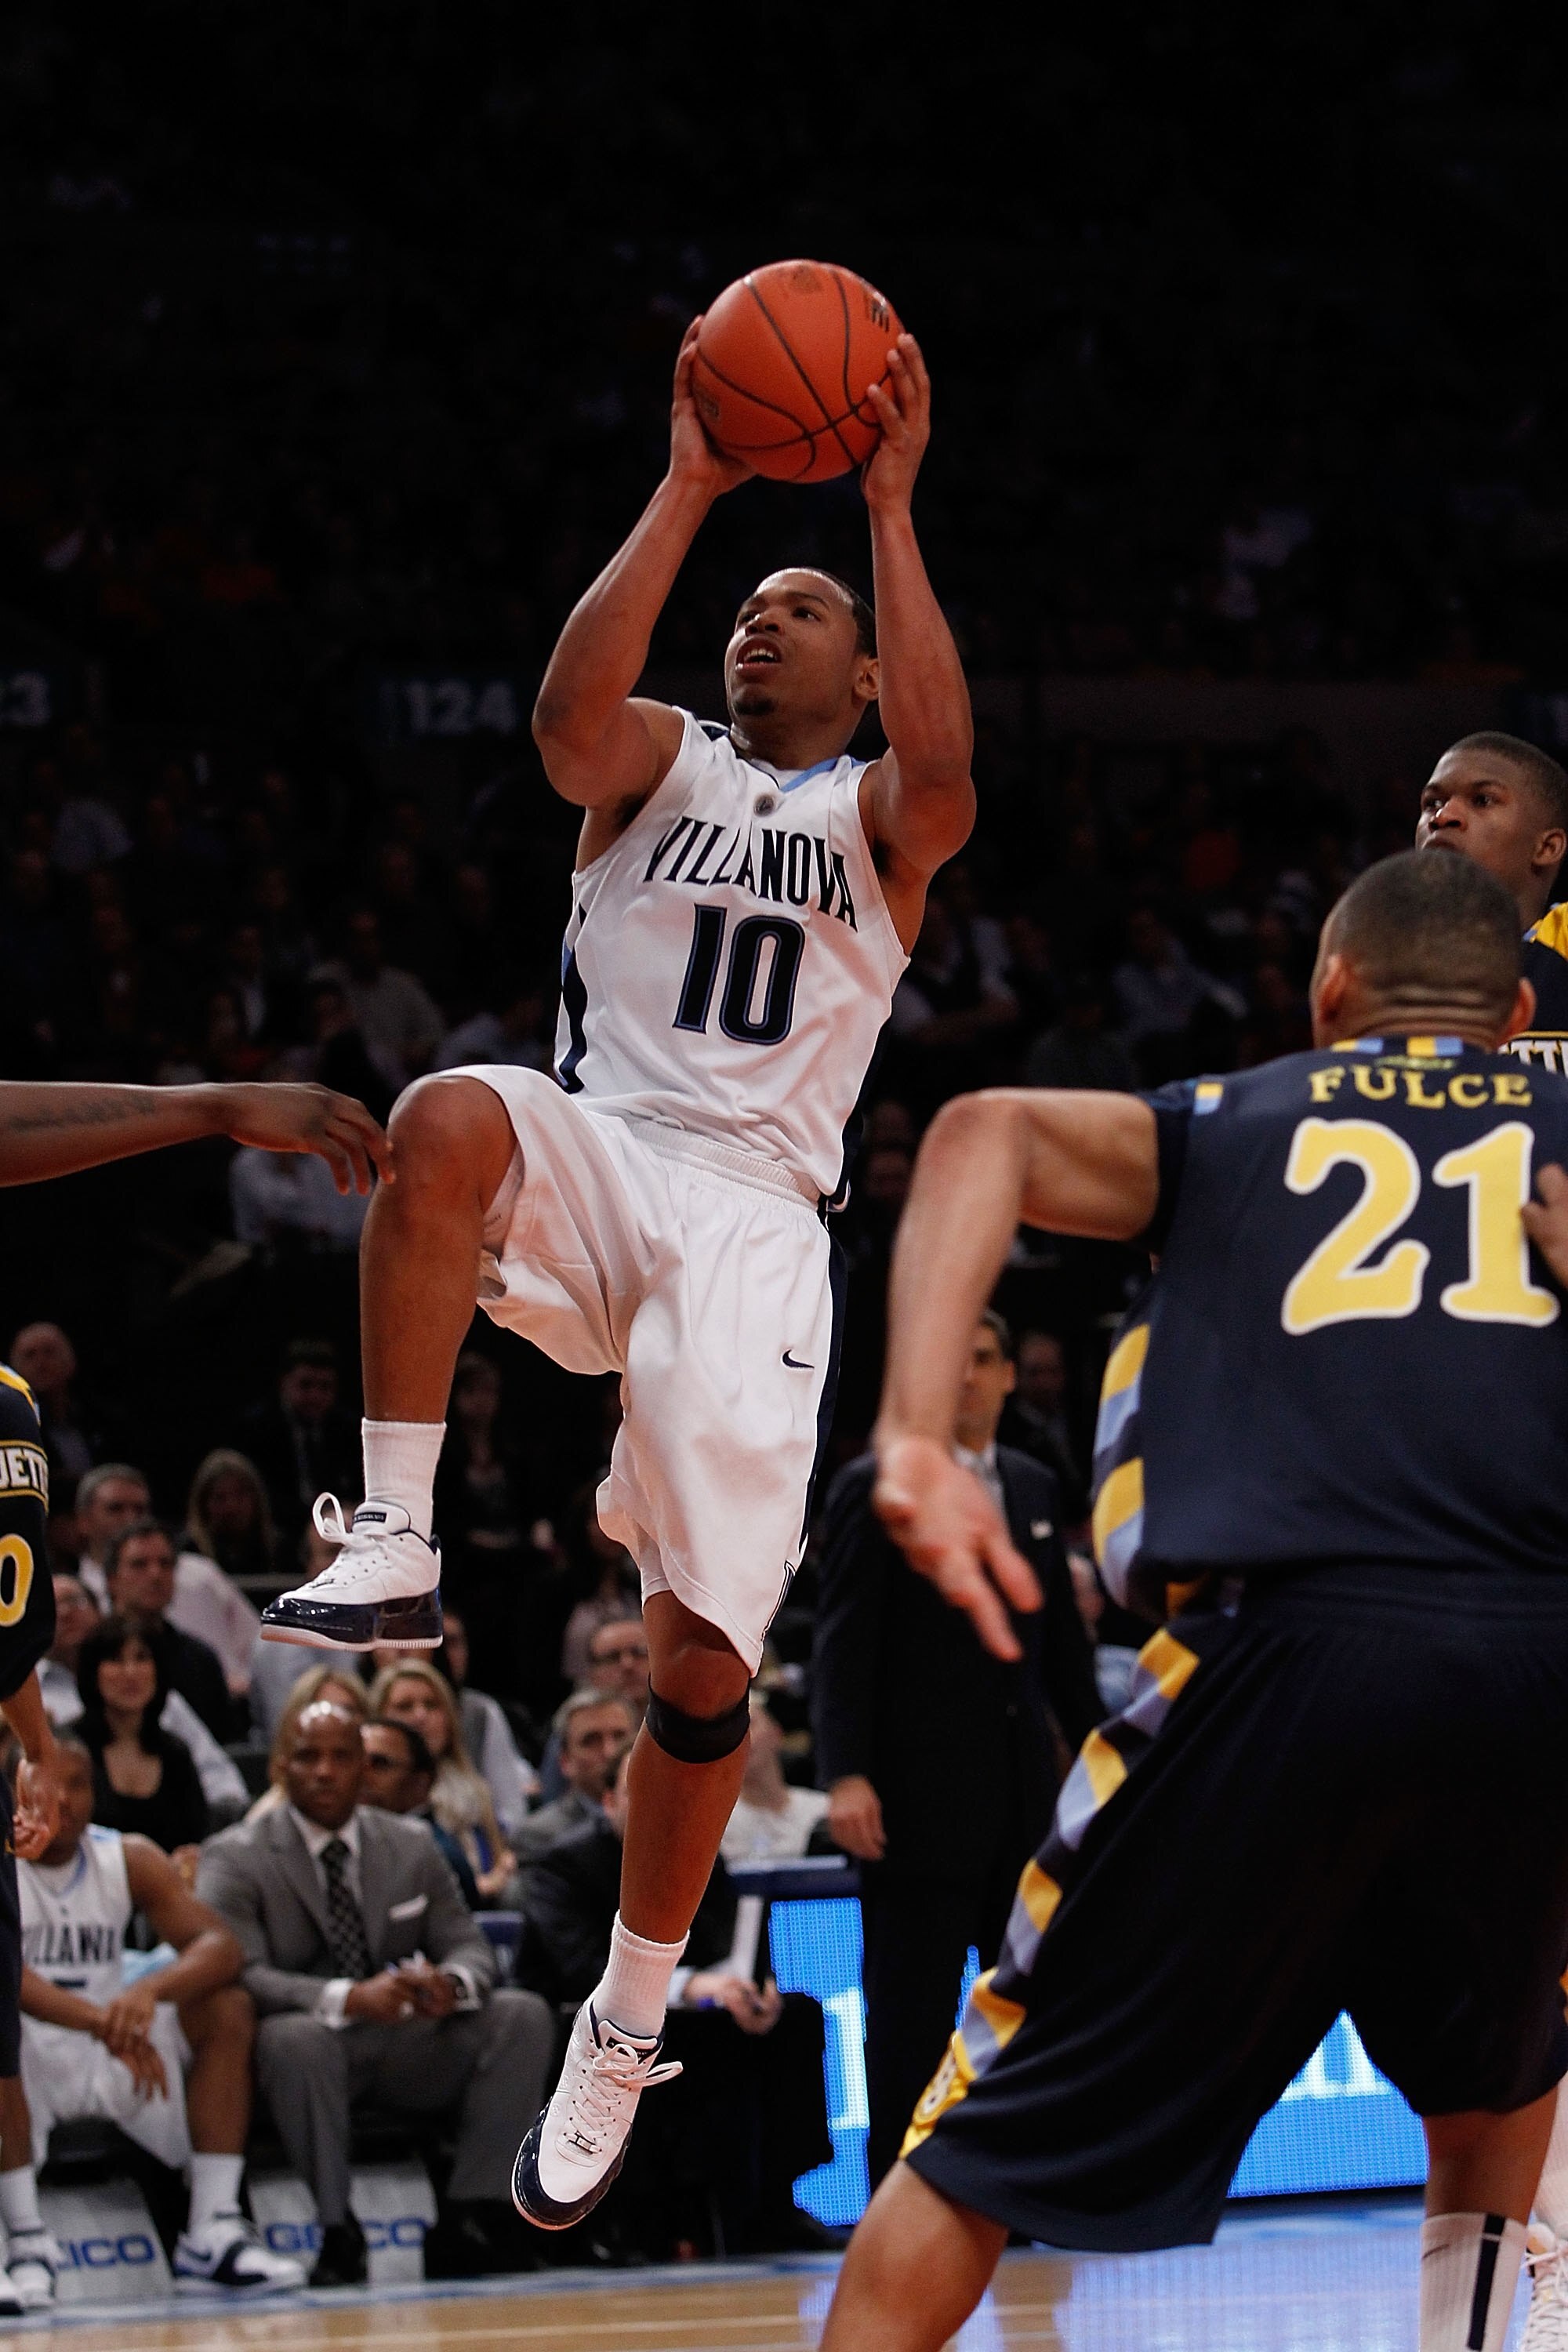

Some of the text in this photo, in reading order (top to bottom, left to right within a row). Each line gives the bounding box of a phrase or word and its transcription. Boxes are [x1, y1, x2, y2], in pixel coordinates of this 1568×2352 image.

[402, 679, 518, 736] 124
[643, 816, 858, 933] VILLANOVA
[671, 902, 806, 1047] 10
[1309, 1064, 1534, 1109] FULCE
[1281, 1116, 1560, 1336] 21
